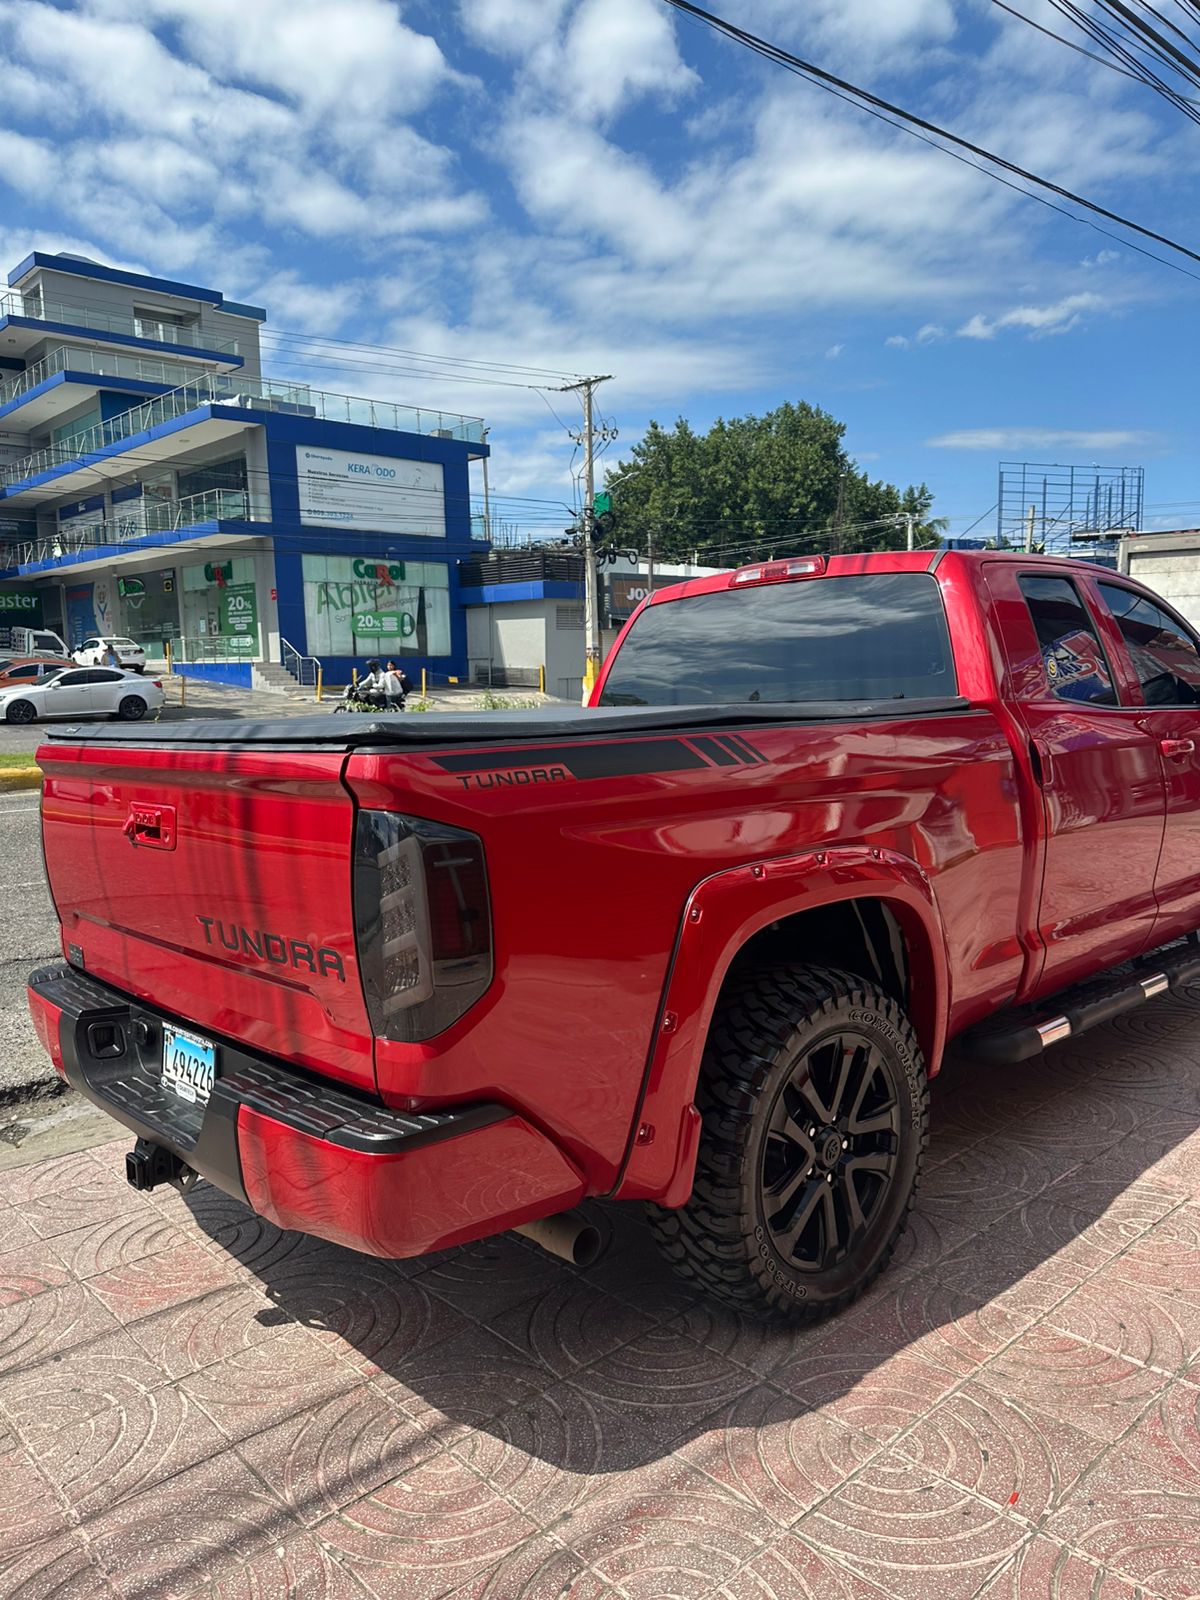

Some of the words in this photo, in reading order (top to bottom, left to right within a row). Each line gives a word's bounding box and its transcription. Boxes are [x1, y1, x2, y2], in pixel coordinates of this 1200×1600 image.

[227, 596, 252, 611] 20%
[357, 615, 381, 627] 20%
[456, 767, 566, 790] TUNDRA
[196, 915, 346, 983] TUNDRA
[164, 1044, 213, 1092] L494226
